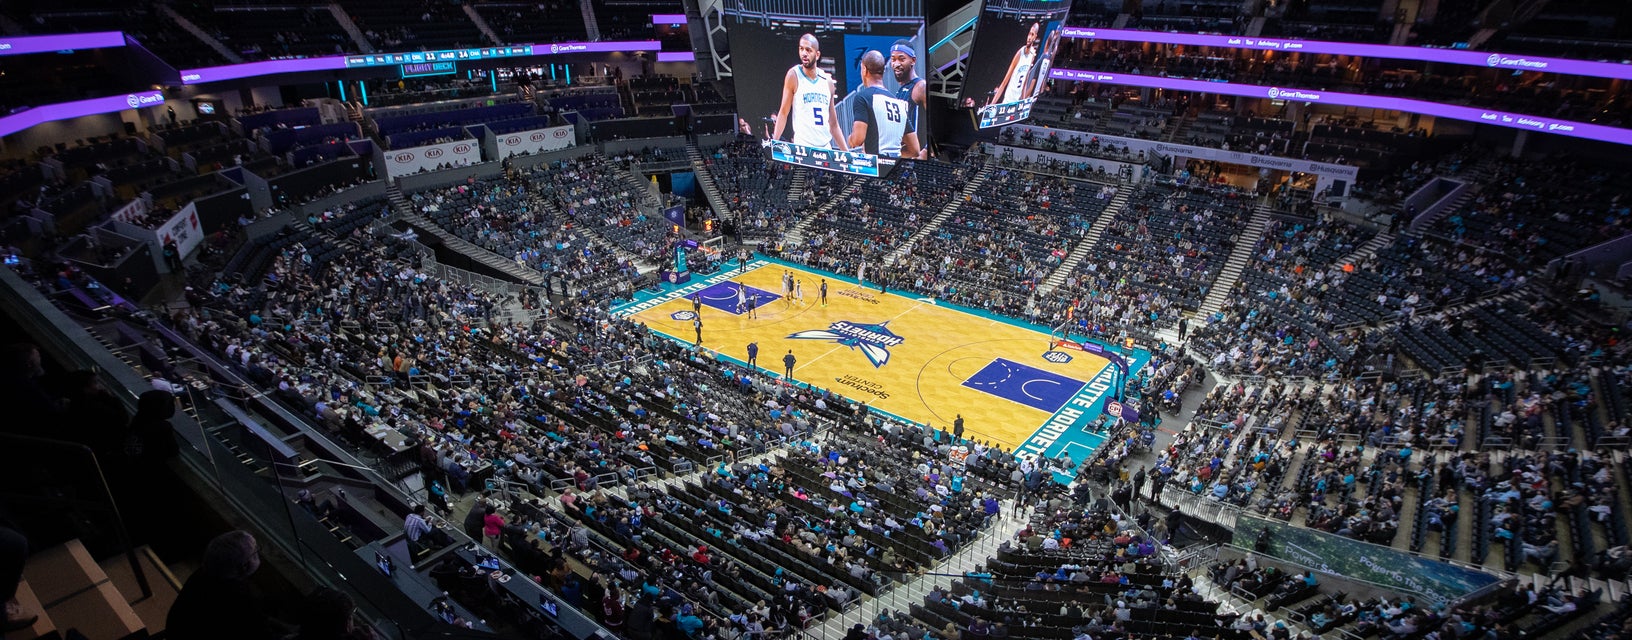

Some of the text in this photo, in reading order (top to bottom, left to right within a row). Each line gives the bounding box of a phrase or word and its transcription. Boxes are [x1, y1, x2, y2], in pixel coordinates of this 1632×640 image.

[1258, 40, 1280, 48] Advisory
[404, 61, 453, 74] FLIGHT DECK
[1077, 72, 1094, 80] Advisory
[803, 92, 828, 106] HORNETS
[1295, 91, 1320, 99] Thornton
[813, 107, 824, 125] 5
[885, 100, 901, 123] 53
[1481, 112, 1498, 120] Audit
[1517, 117, 1545, 129] Advisory
[1548, 122, 1574, 131] gt.com
[795, 145, 808, 157] 11
[812, 151, 828, 160] 4:48
[833, 151, 848, 163] 14
[1163, 145, 1193, 154] Husqvarna
[1257, 158, 1292, 168] Husqvarna
[1317, 165, 1354, 176] Husqvarna
[832, 321, 902, 346] HORNETS
[838, 378, 890, 400] Spectrum
[843, 374, 883, 390] CENTER
[1016, 406, 1083, 462] HORNETS
[1360, 555, 1390, 576] Power
[1390, 571, 1403, 582] To
[1404, 577, 1423, 592] The
